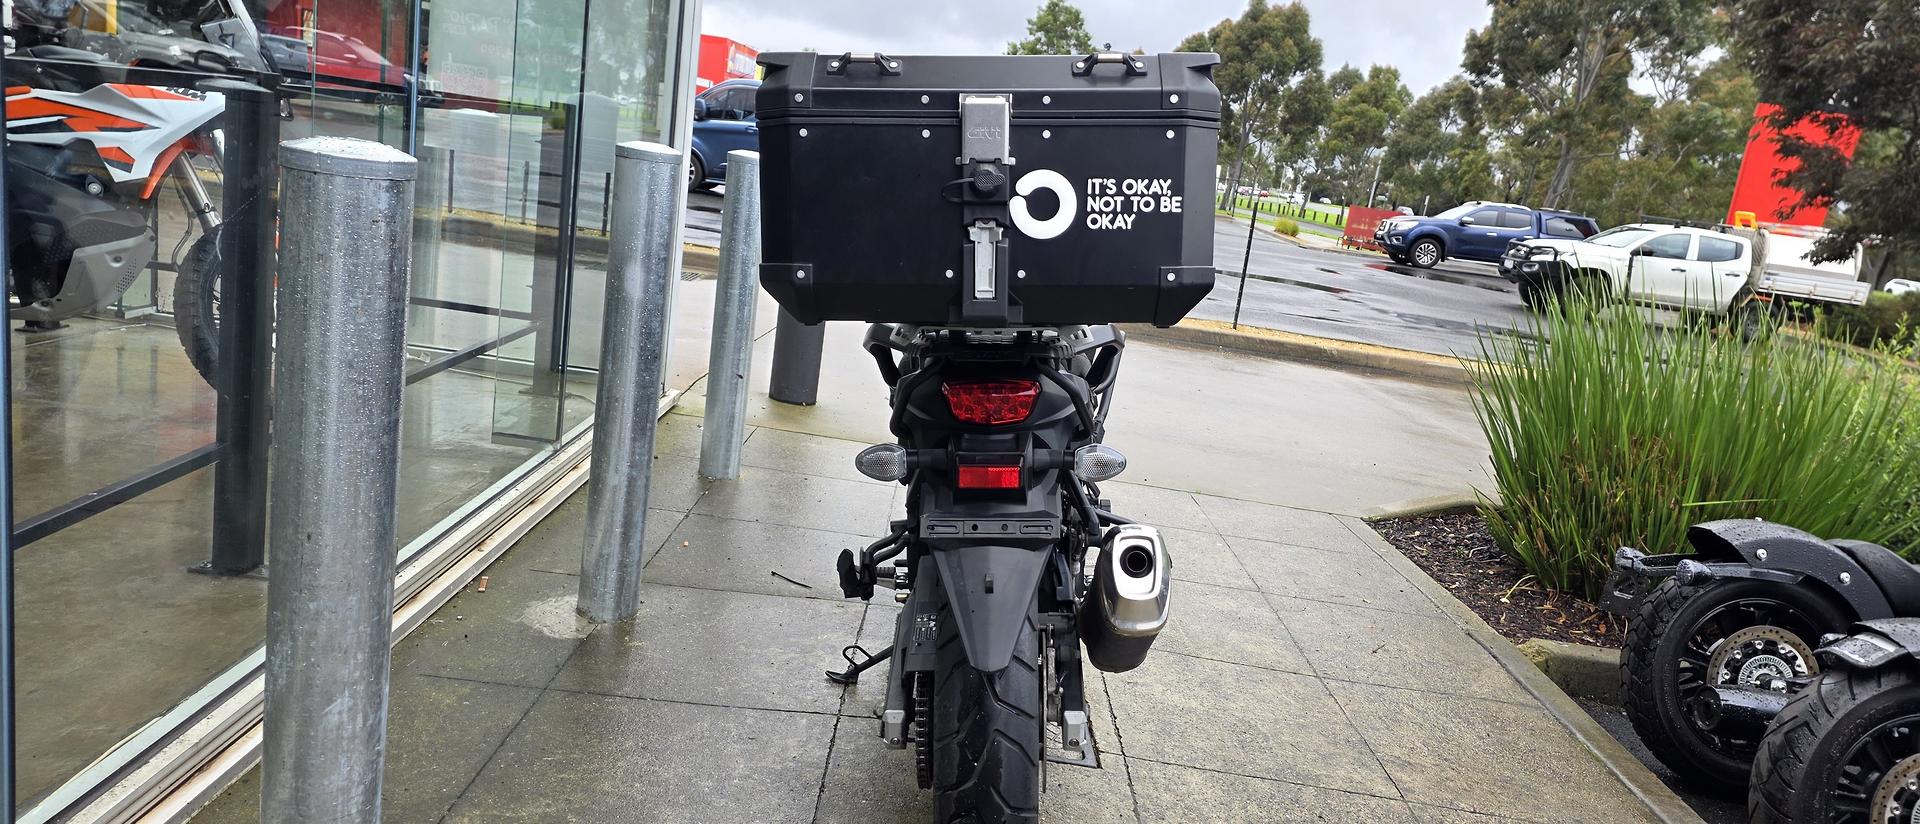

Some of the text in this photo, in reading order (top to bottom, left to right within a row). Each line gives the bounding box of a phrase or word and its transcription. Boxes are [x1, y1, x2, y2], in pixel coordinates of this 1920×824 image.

[1087, 178, 1172, 197] IT'S OKAY,
[1086, 196, 1183, 213] NOT TO BE
[1086, 213, 1136, 230] OKAY
